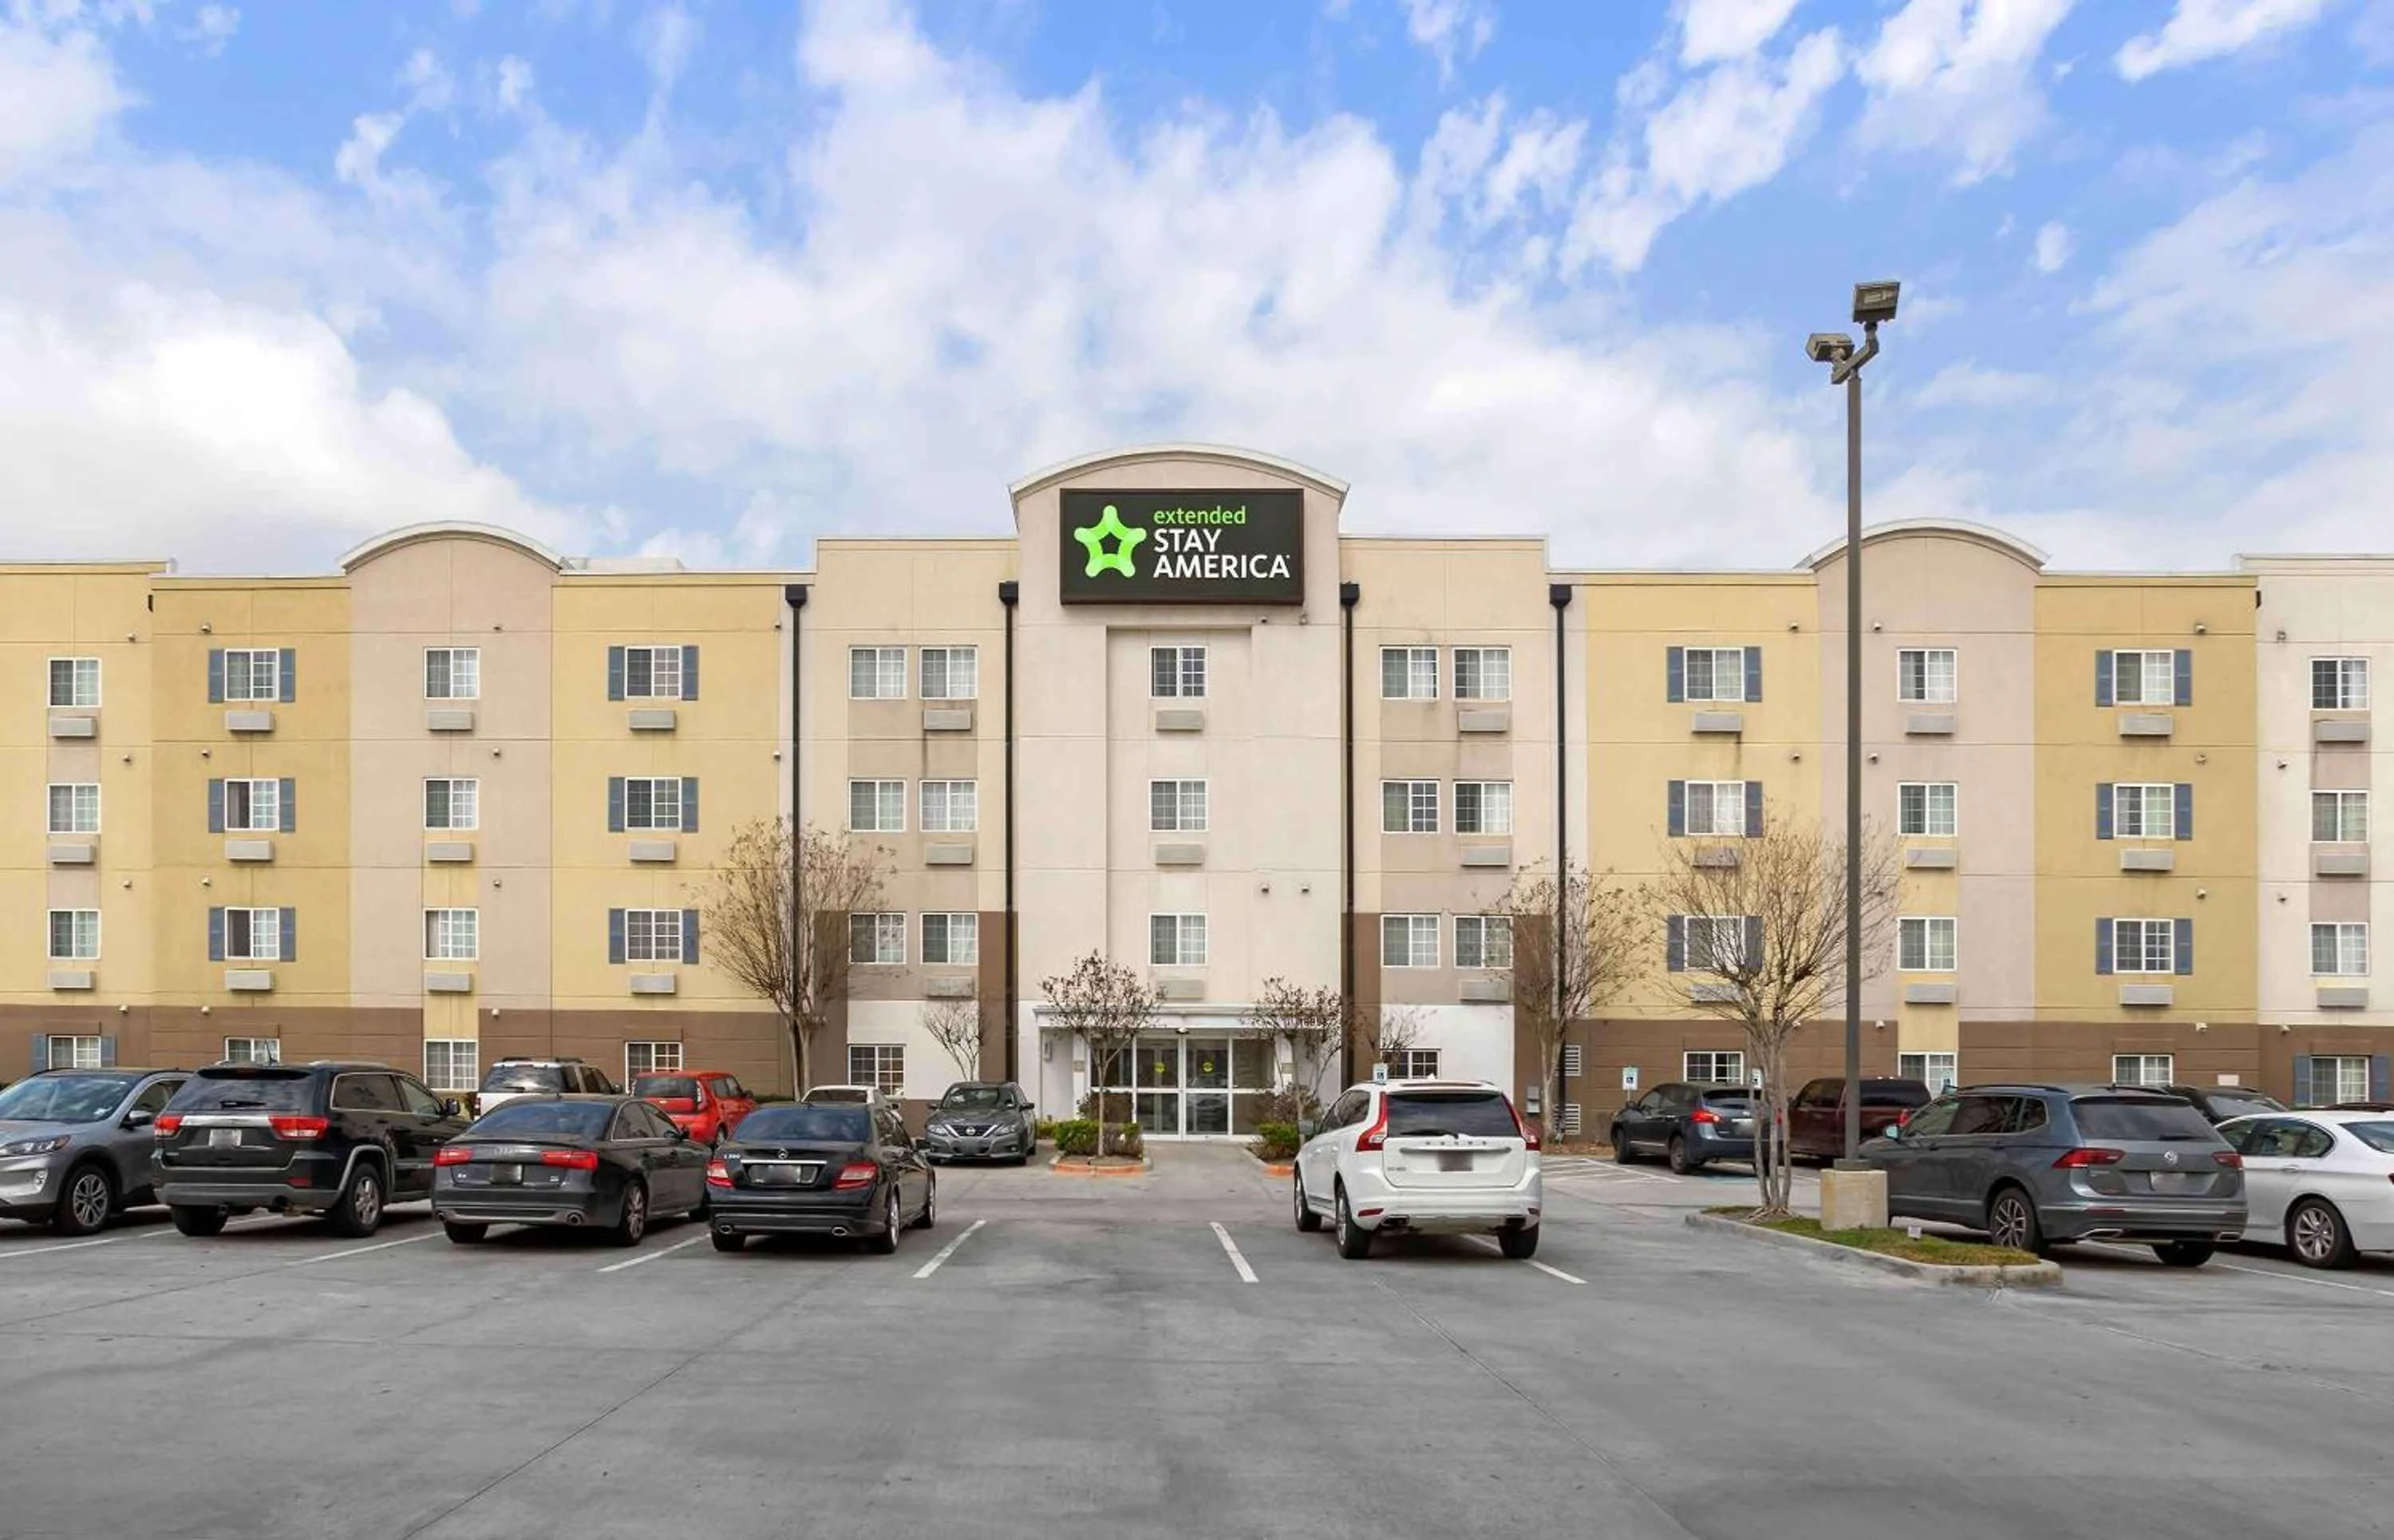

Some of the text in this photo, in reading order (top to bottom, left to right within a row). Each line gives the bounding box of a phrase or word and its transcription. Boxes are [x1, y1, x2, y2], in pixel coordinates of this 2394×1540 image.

[1153, 505, 1246, 524] extended
[1154, 528, 1223, 553] STAY
[1153, 555, 1290, 578] AMERICA
